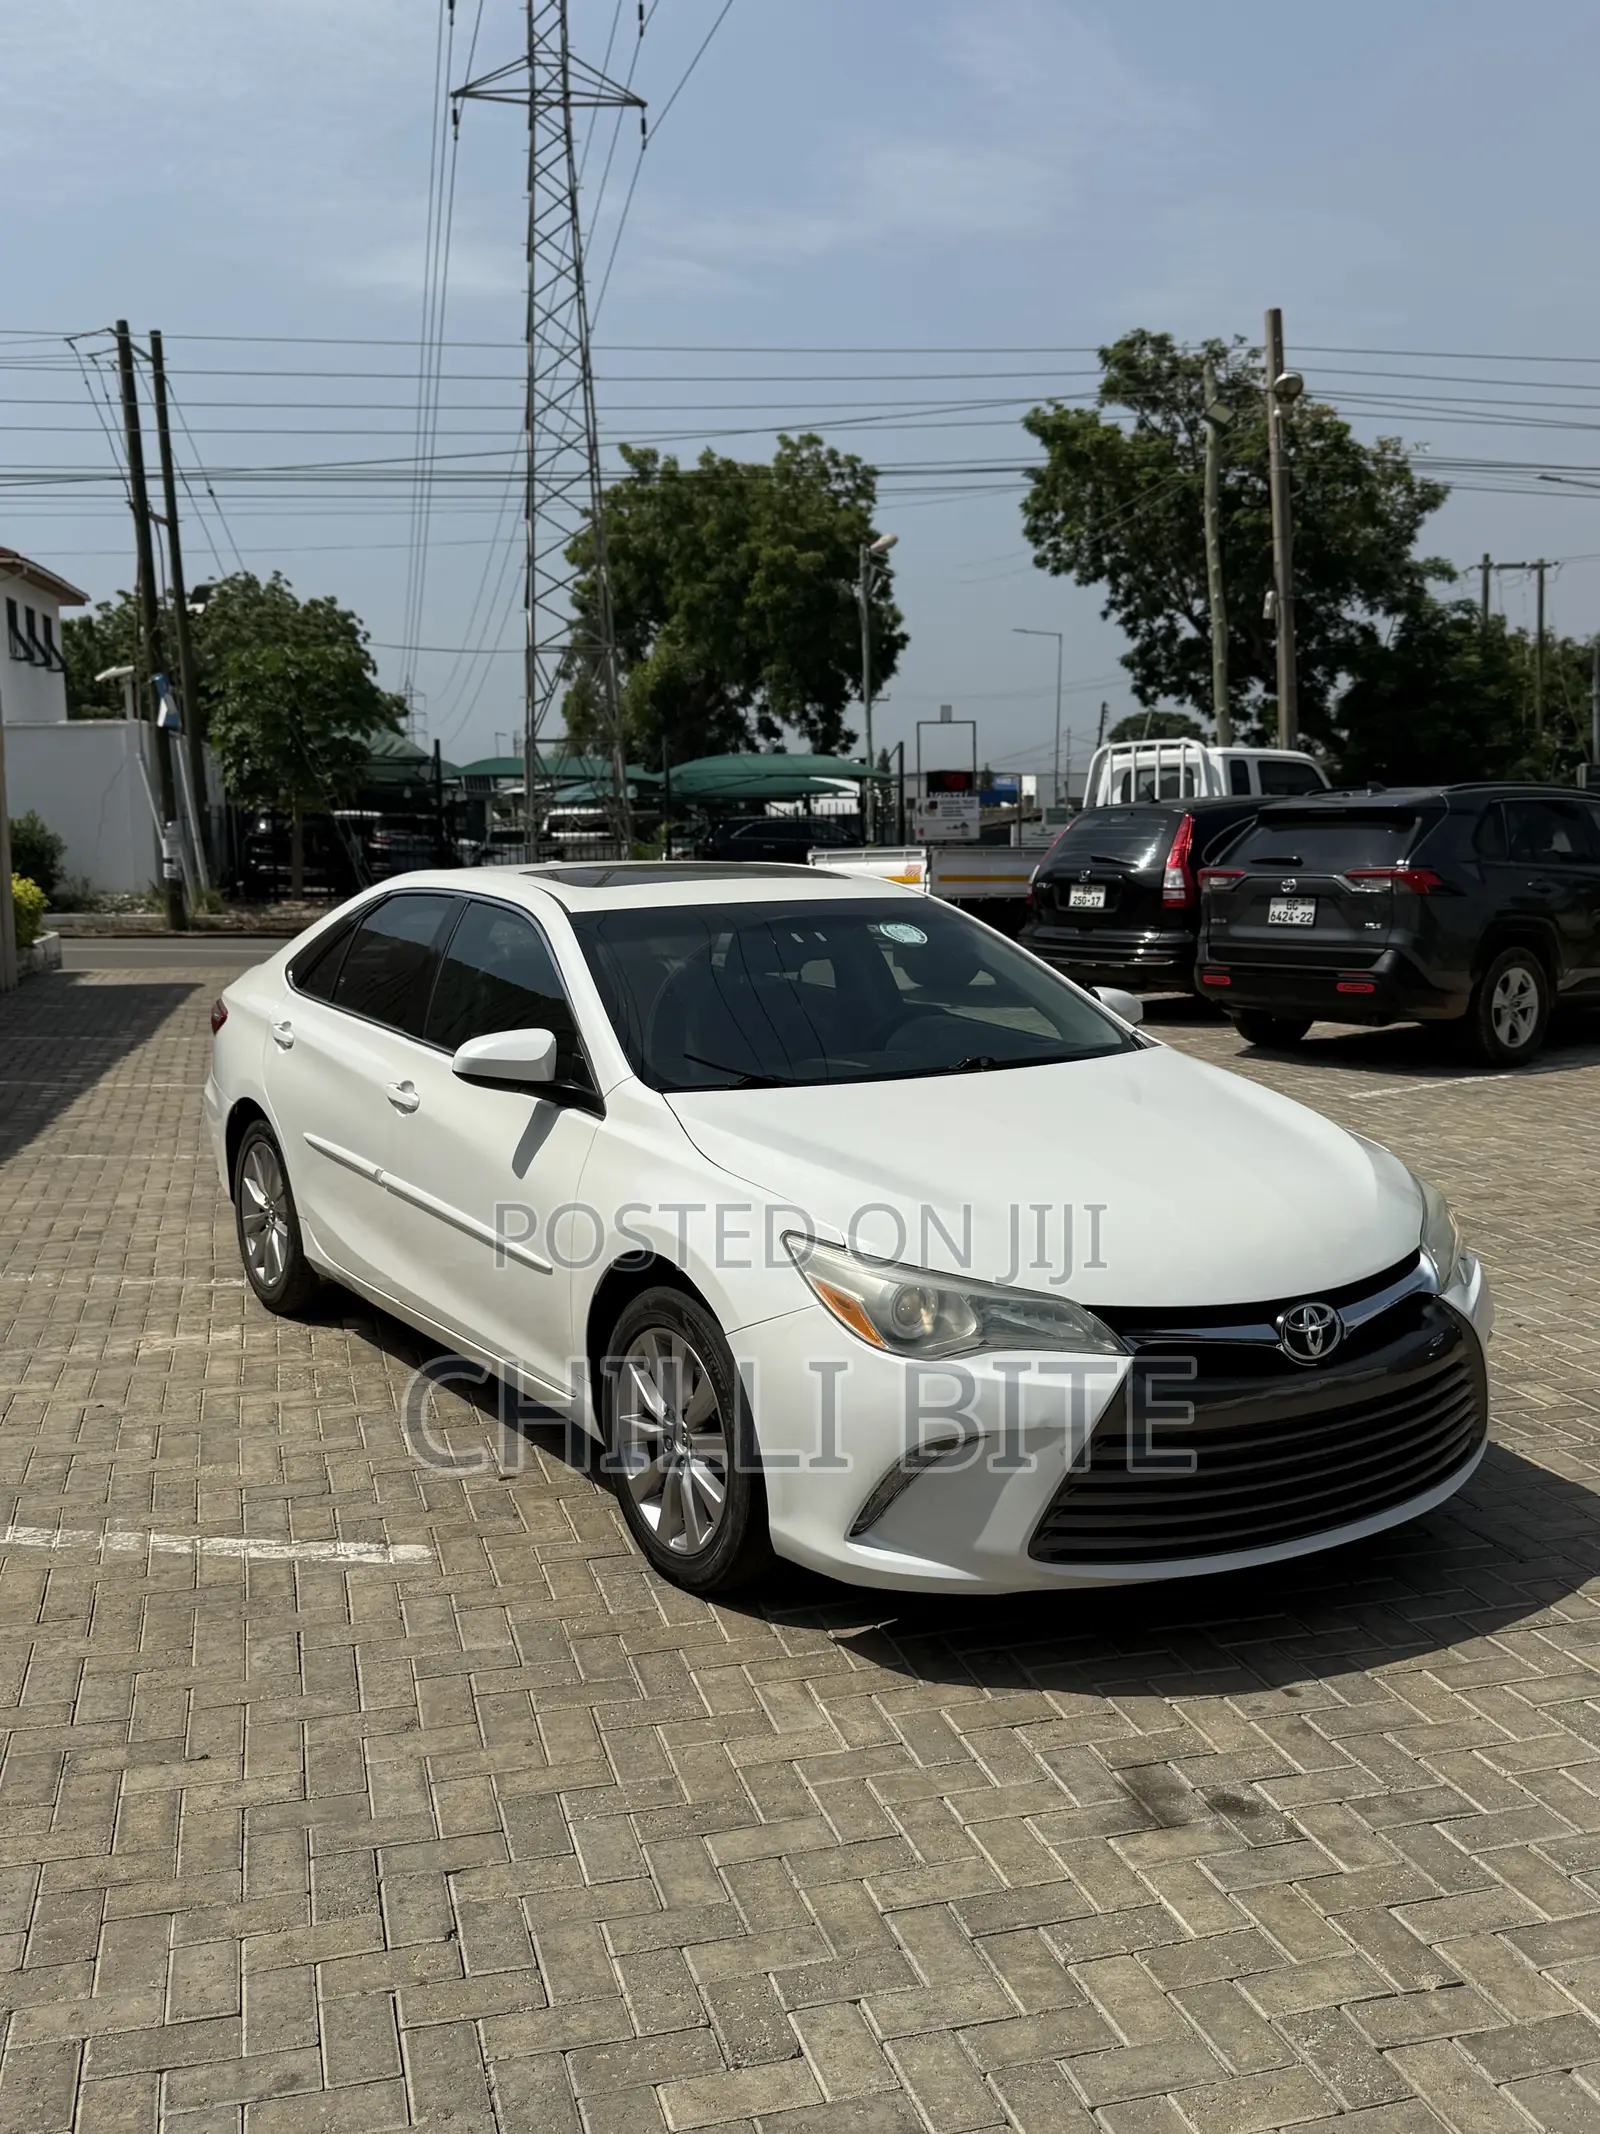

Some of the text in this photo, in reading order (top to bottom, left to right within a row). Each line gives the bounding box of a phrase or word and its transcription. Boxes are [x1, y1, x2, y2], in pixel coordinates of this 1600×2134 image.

[1072, 896, 1101, 906] 250-17
[1286, 899, 1299, 911] GC
[1270, 911, 1313, 923] 6424-22
